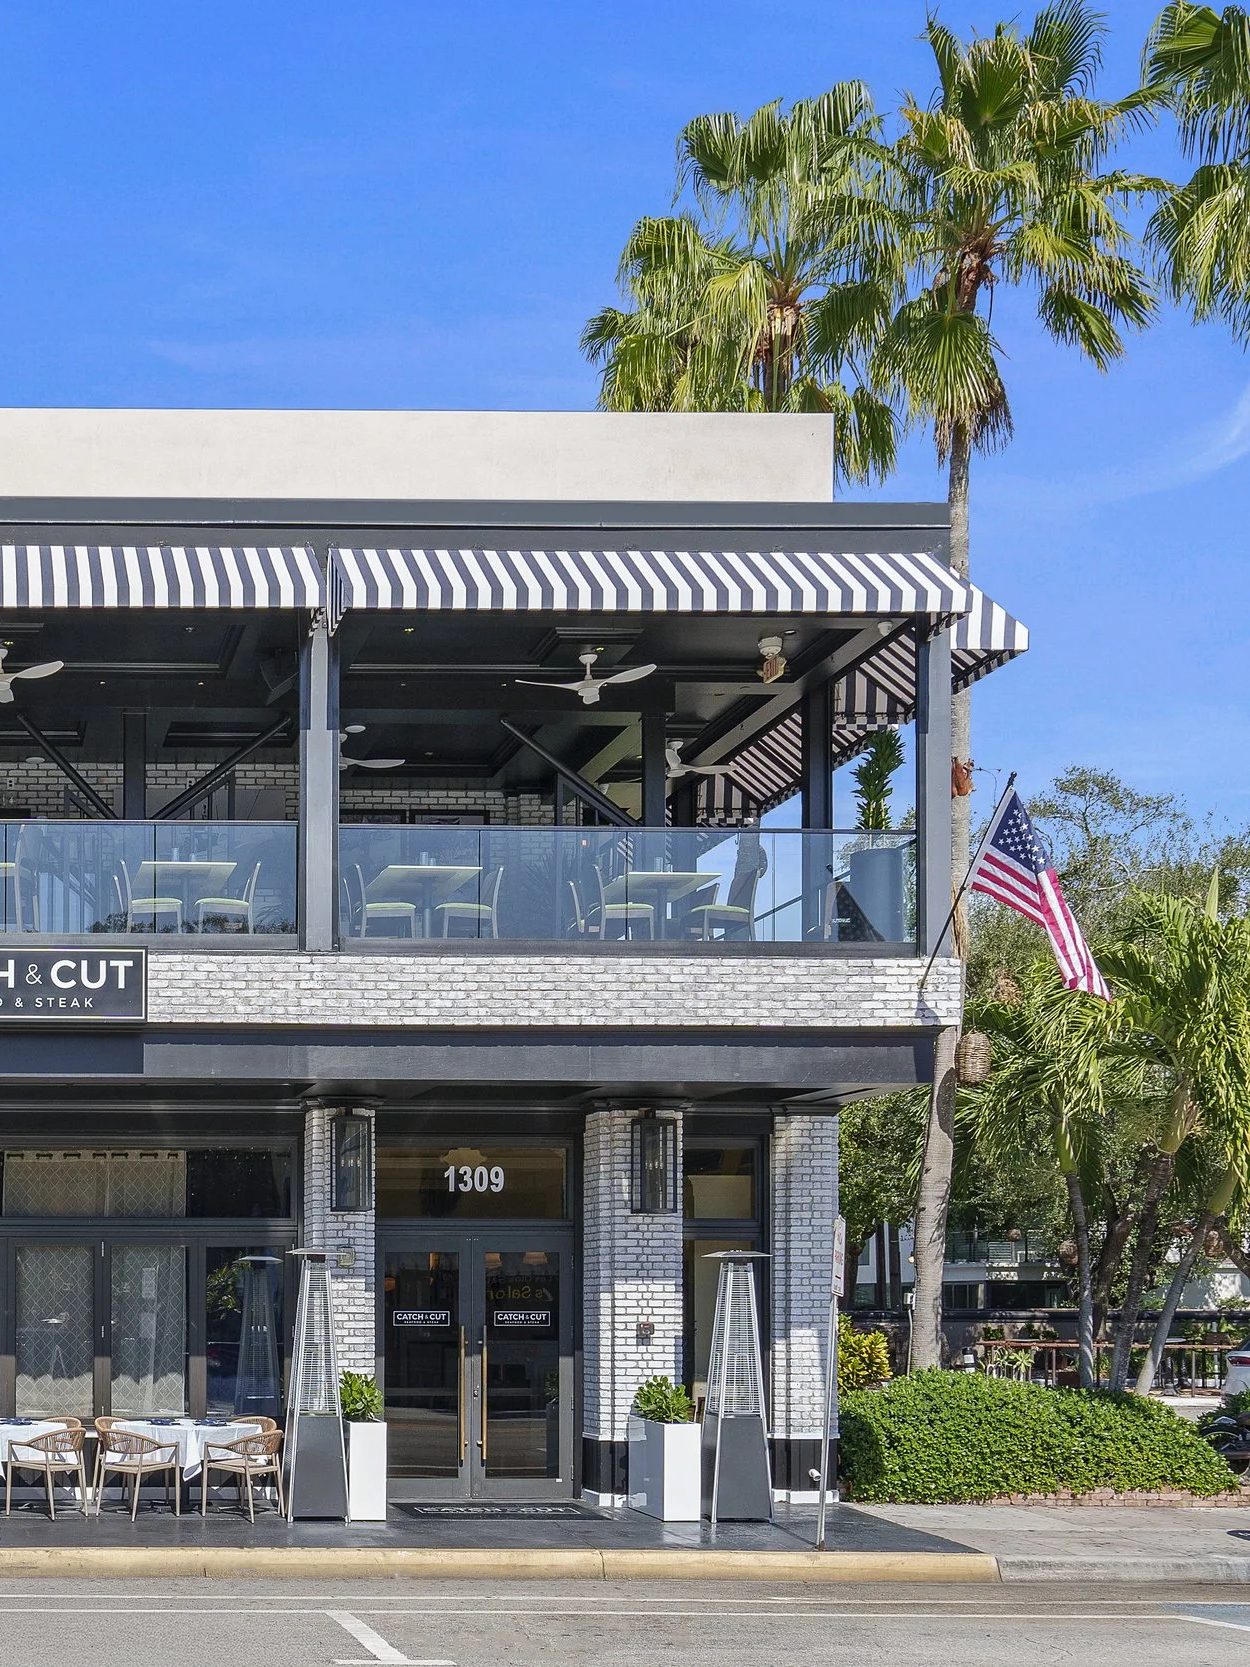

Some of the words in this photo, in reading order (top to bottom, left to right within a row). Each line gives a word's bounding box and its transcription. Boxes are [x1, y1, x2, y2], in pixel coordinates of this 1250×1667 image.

[25, 963, 43, 986] &
[50, 959, 134, 989] CUT
[14, 997, 24, 1008] &
[35, 997, 94, 1008] STEAK
[444, 1165, 505, 1192] 1309
